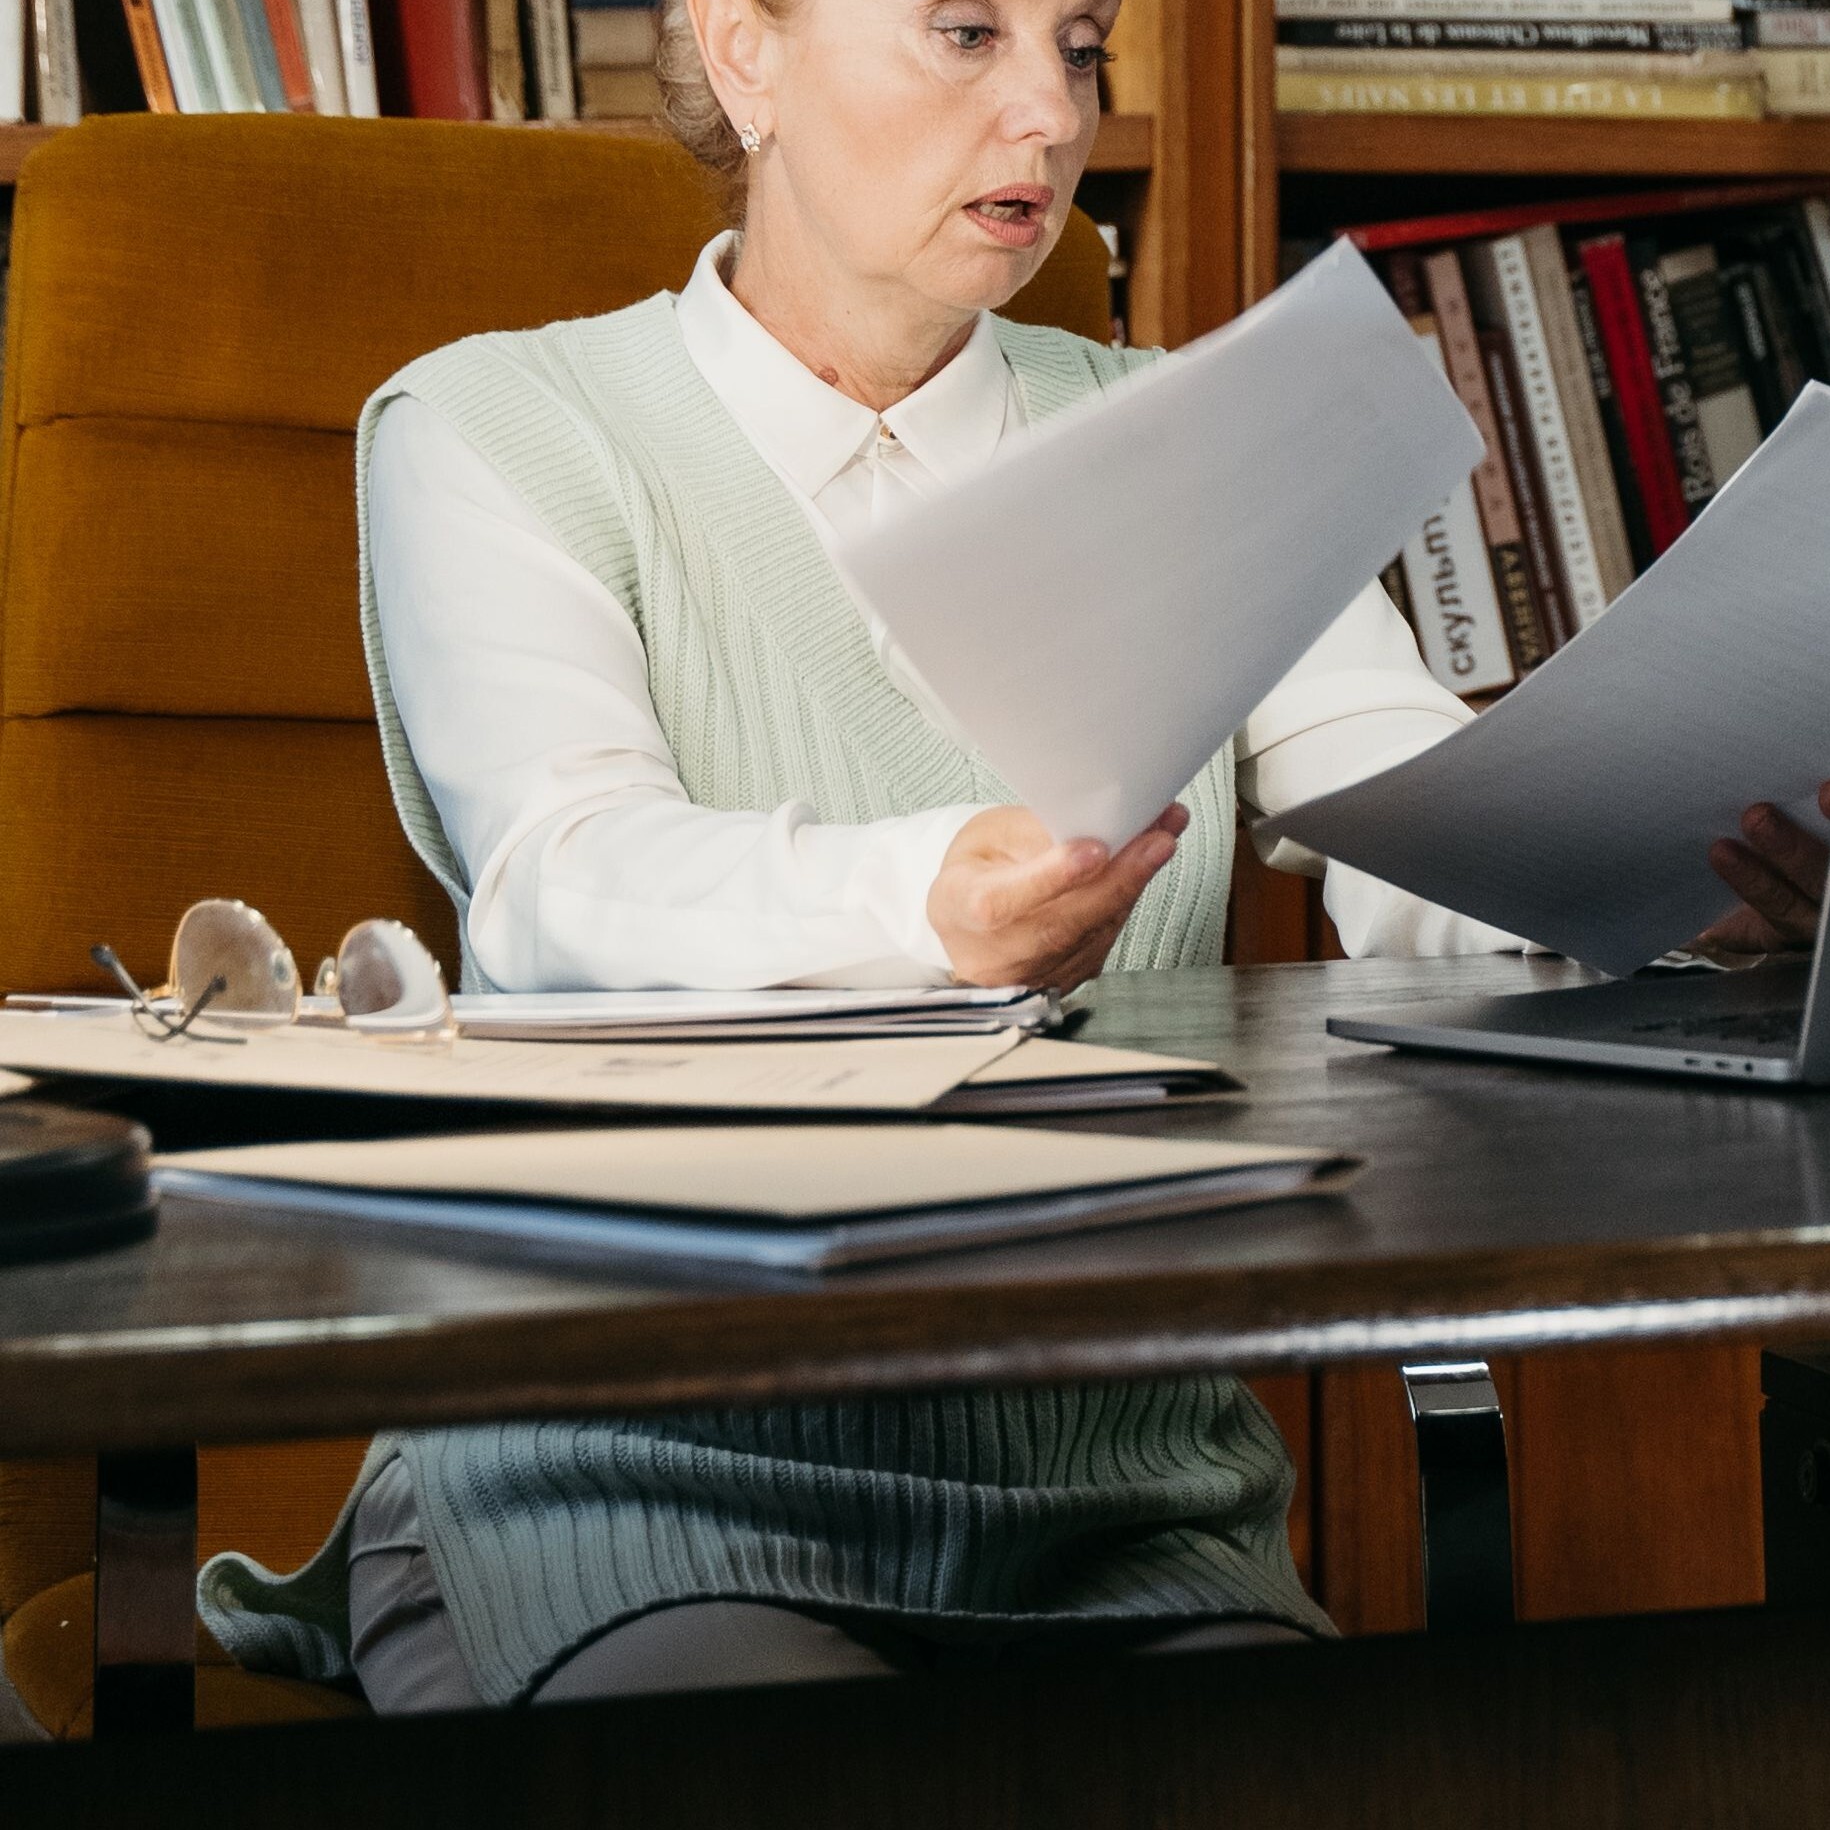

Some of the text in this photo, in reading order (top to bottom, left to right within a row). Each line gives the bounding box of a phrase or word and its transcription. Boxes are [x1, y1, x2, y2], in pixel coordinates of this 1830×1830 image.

[1639, 268, 1687, 379] France
[1662, 382, 1697, 426] de
[1423, 512, 1476, 675] скульпт
